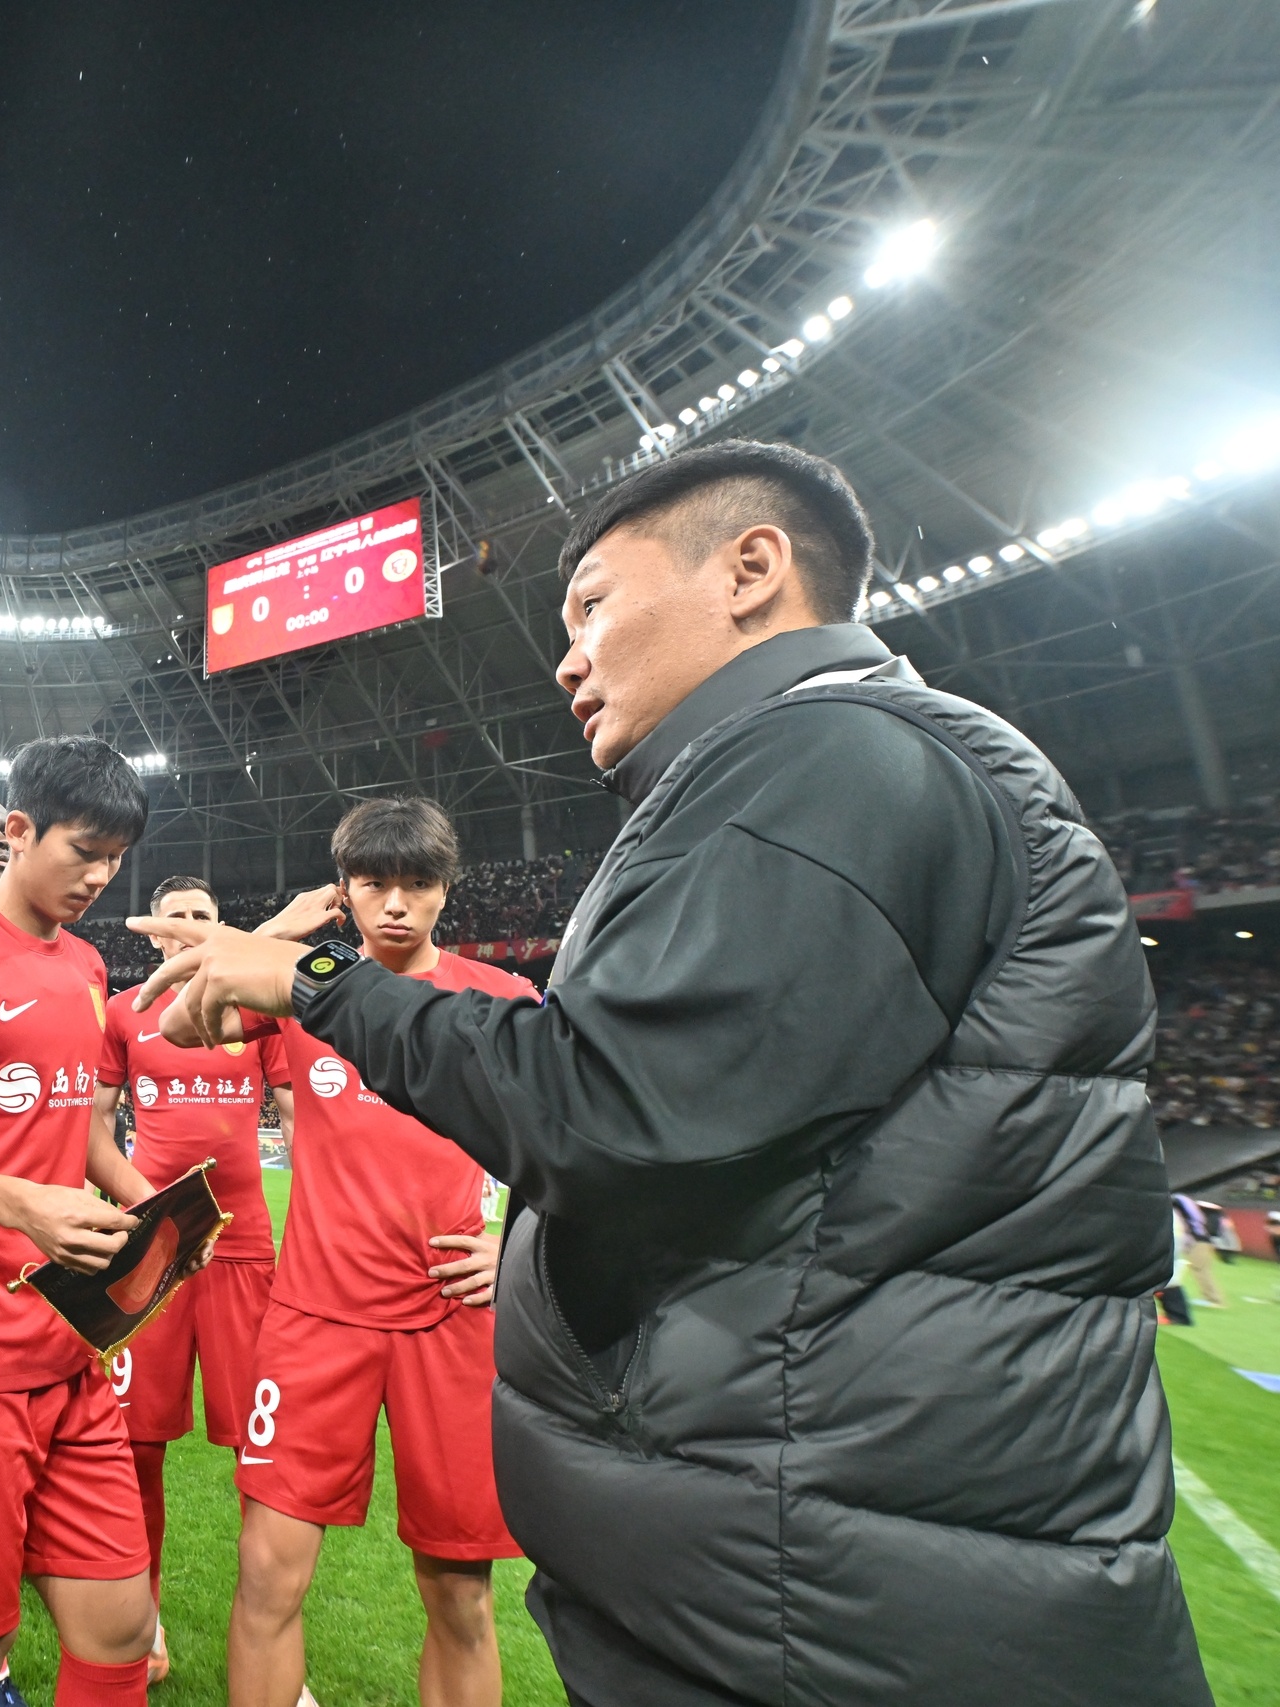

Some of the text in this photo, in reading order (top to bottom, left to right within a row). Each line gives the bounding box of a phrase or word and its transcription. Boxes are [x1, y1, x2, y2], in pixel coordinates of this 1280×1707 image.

[252, 596, 270, 622] 0
[344, 566, 365, 594] 0
[286, 607, 329, 632] 00:00
[166, 1075, 254, 1096] 西南证券
[112, 1347, 133, 1397] 9
[247, 1378, 281, 1448] 8
